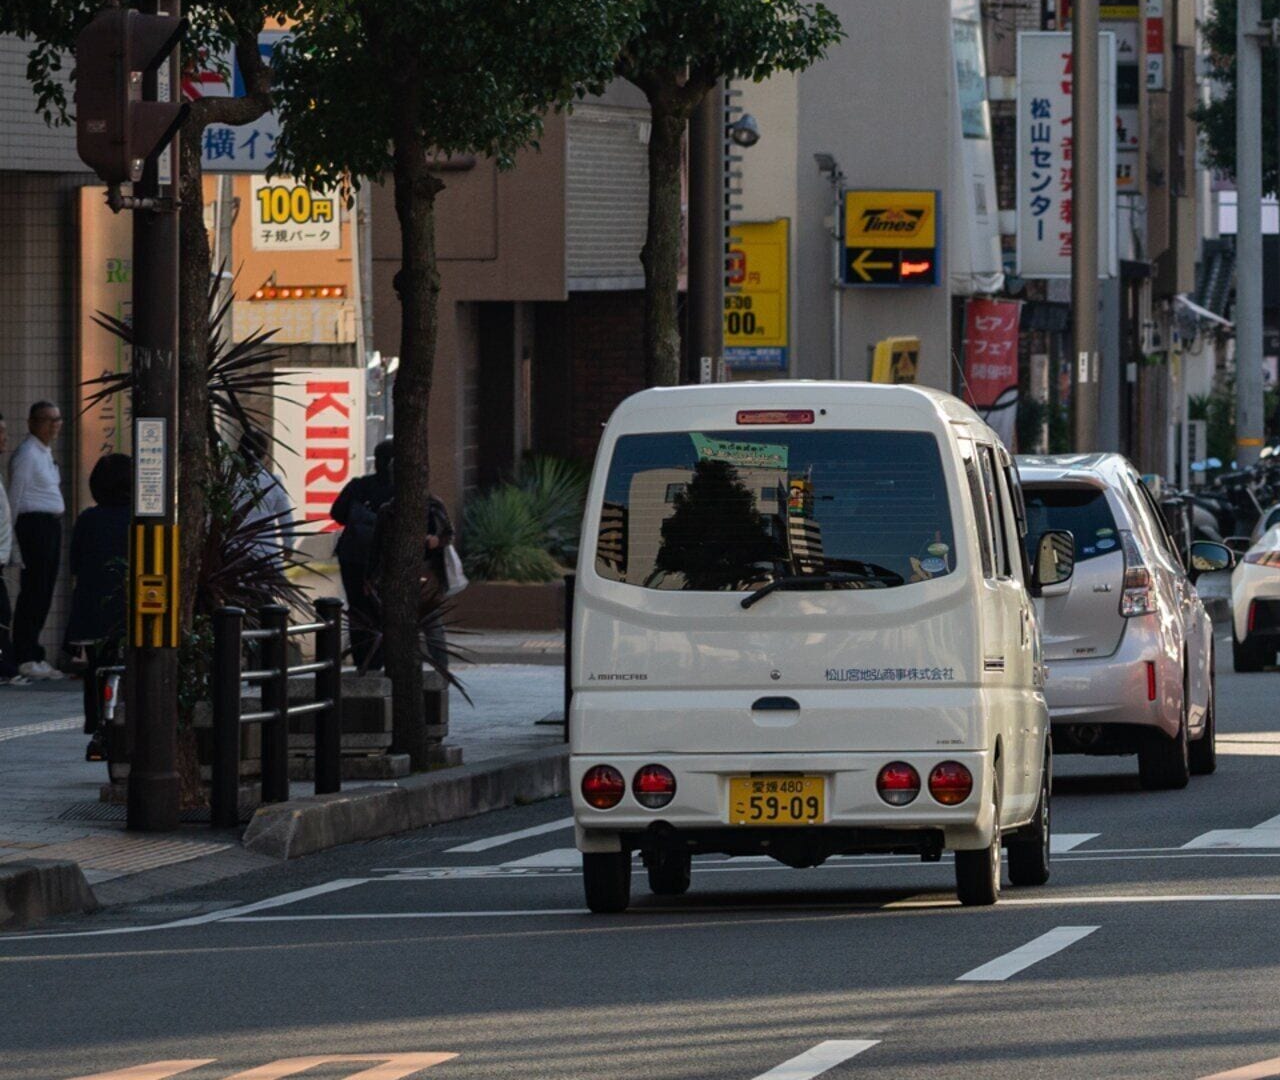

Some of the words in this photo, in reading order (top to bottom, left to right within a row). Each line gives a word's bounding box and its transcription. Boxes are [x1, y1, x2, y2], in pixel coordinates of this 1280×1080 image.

[1029, 97, 1053, 240] 松山センター
[257, 185, 334, 224] 100円
[863, 208, 924, 232] Times
[261, 228, 331, 244] 子規パーク
[750, 795, 819, 820] 59-09
